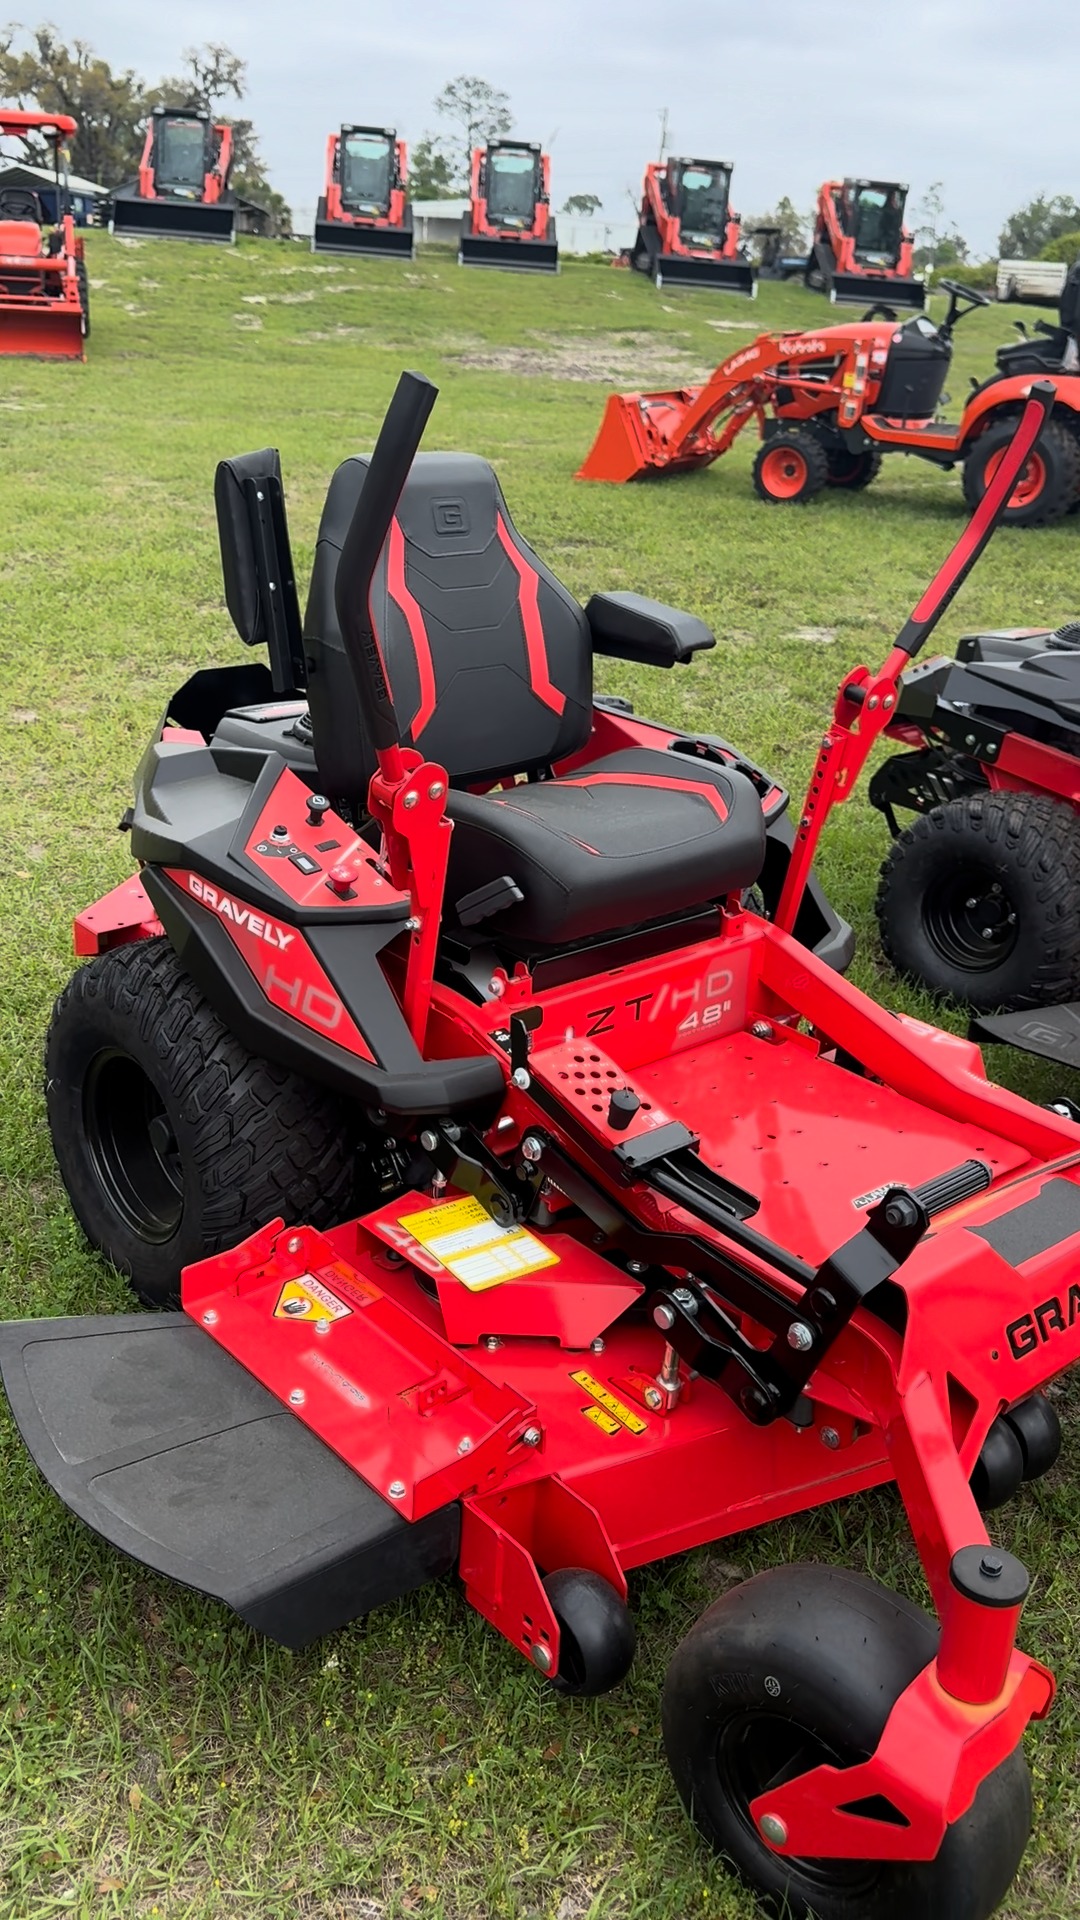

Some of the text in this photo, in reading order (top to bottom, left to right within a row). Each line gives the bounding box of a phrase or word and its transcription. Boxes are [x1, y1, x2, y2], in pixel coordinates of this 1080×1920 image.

[779, 340, 826, 355] Kubota
[189, 873, 296, 950] GRAVELY
[265, 964, 345, 1029] HD
[303, 1279, 343, 1313] DANGER
